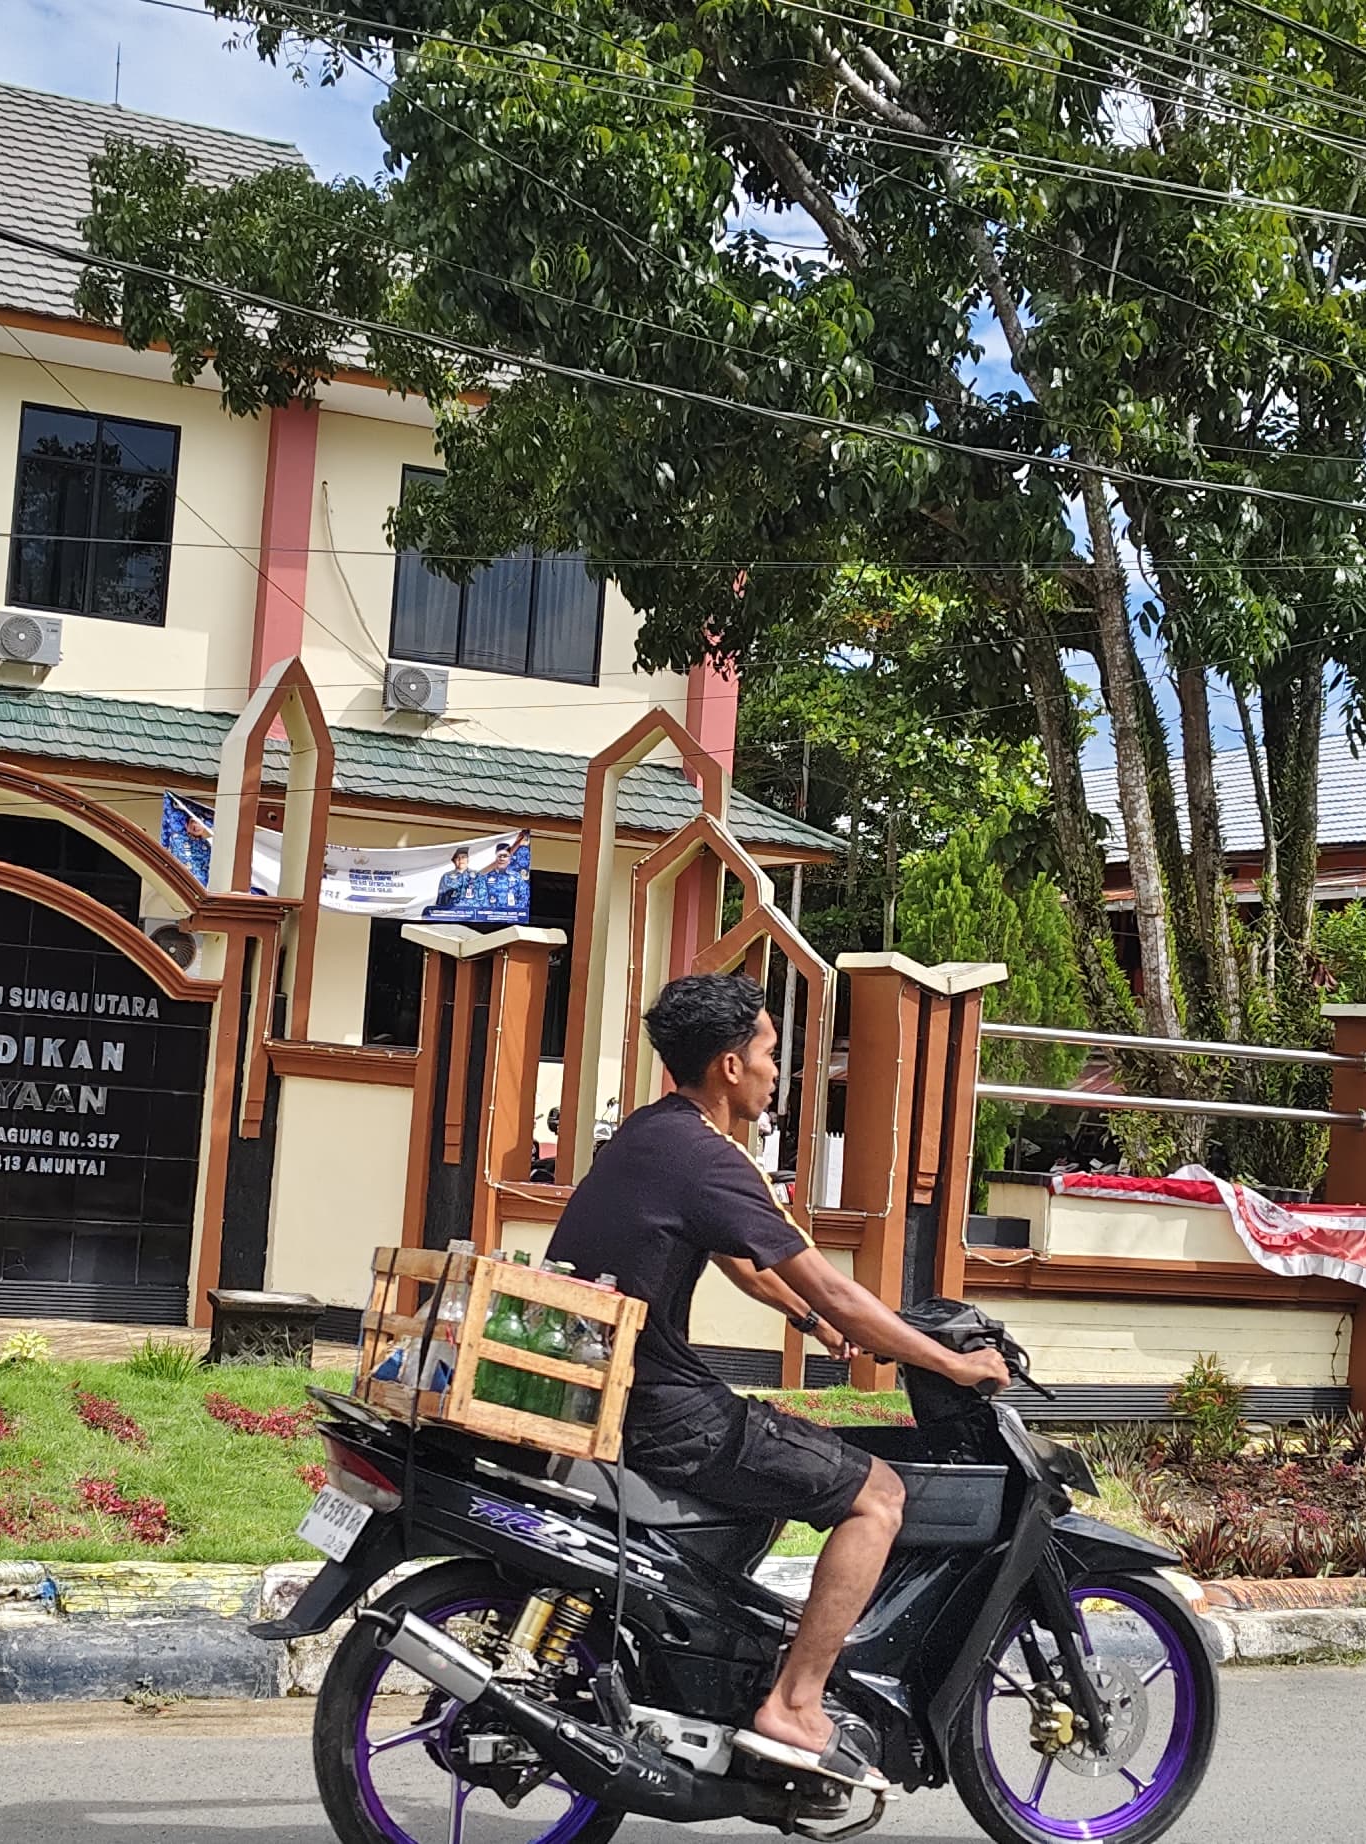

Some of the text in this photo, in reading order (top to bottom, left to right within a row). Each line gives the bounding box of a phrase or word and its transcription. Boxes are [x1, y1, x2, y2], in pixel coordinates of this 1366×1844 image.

[8, 986, 88, 1013] SUNGAI
[93, 993, 159, 1019] UTARA
[58, 1130, 120, 1149] NO.357
[25, 1156, 106, 1176] AMUNTAI
